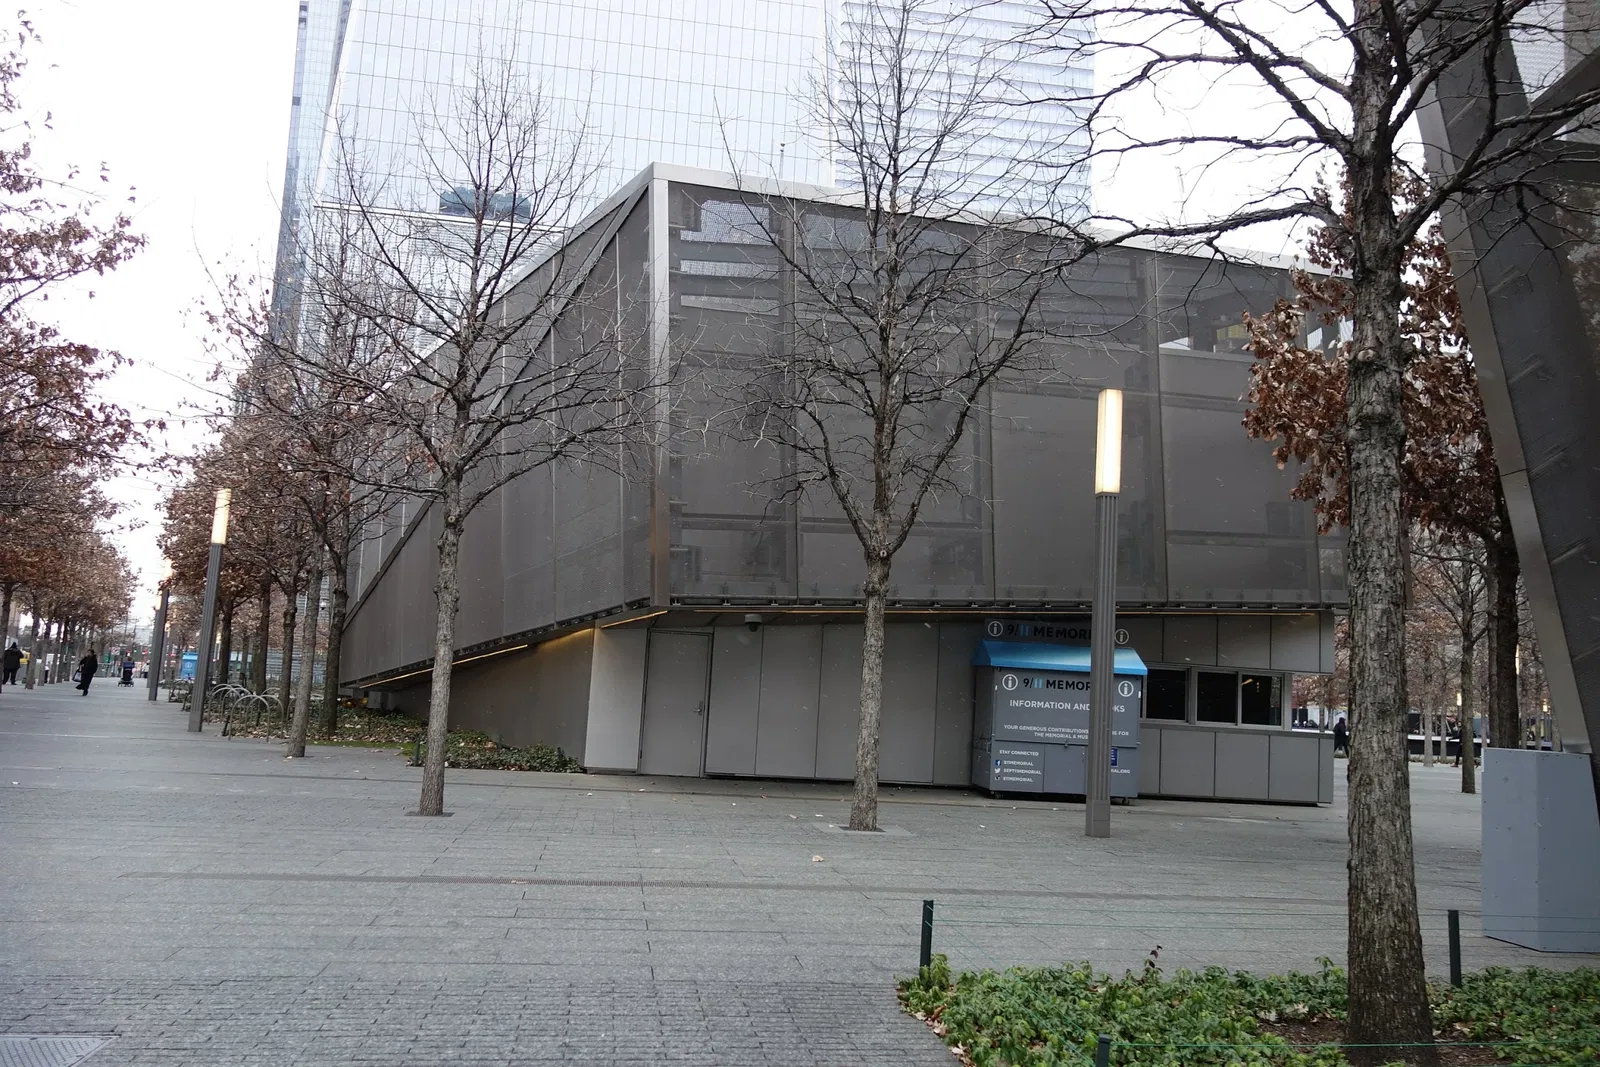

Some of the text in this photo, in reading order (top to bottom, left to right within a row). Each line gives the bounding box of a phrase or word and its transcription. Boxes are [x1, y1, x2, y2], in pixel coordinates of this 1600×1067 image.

[1033, 625, 1091, 640] MEMORI
[1023, 677, 1043, 689] 9/11
[1009, 699, 1071, 710] INFORMATION
[1047, 726, 1089, 734] CONTRIBUTIONS
